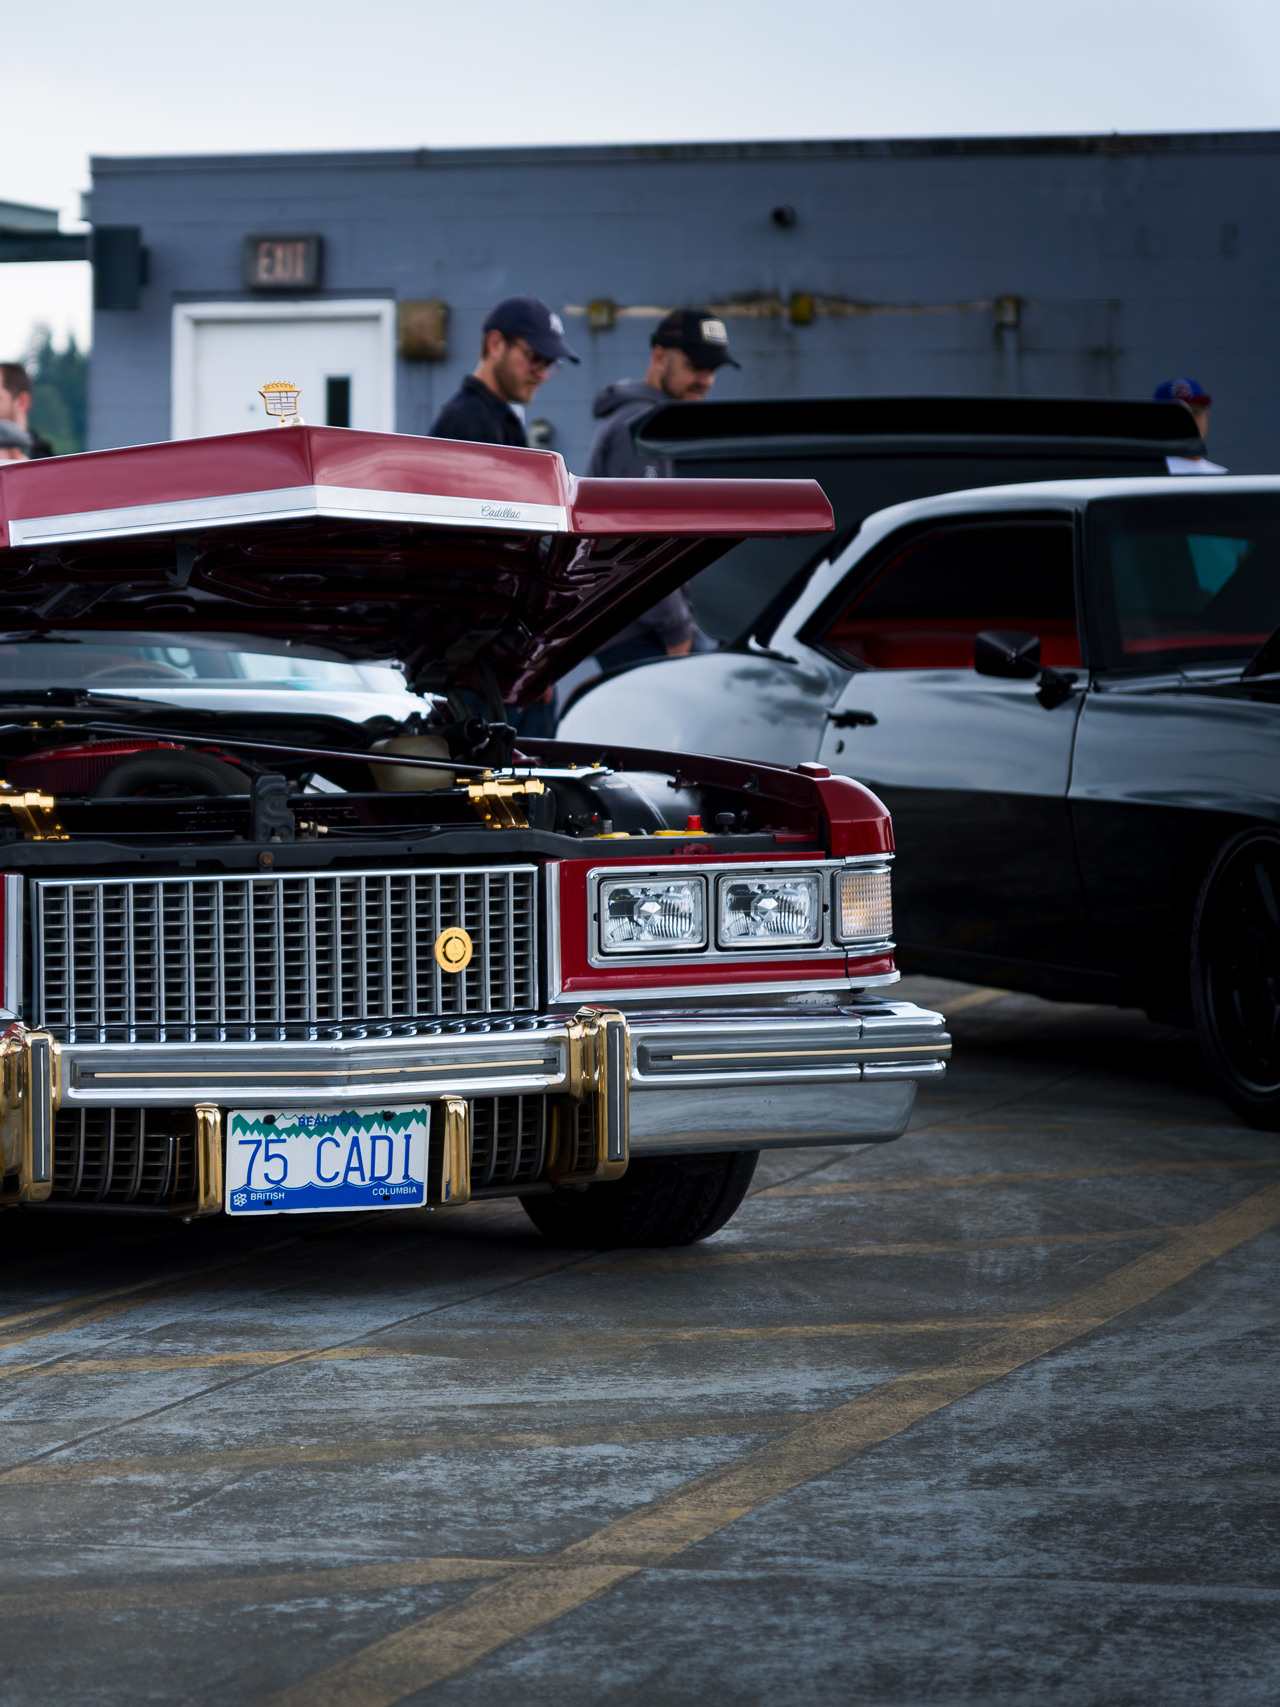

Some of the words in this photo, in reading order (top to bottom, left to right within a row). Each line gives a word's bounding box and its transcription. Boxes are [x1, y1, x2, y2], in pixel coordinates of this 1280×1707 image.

[258, 241, 305, 280] EXIT
[481, 505, 521, 519] Cadillac
[298, 1115, 363, 1128] BEAUTIFUL
[238, 1138, 289, 1186] 75
[315, 1133, 412, 1183] CADI
[250, 1192, 285, 1202] BRITISH
[372, 1186, 418, 1197] COLUMBIA
